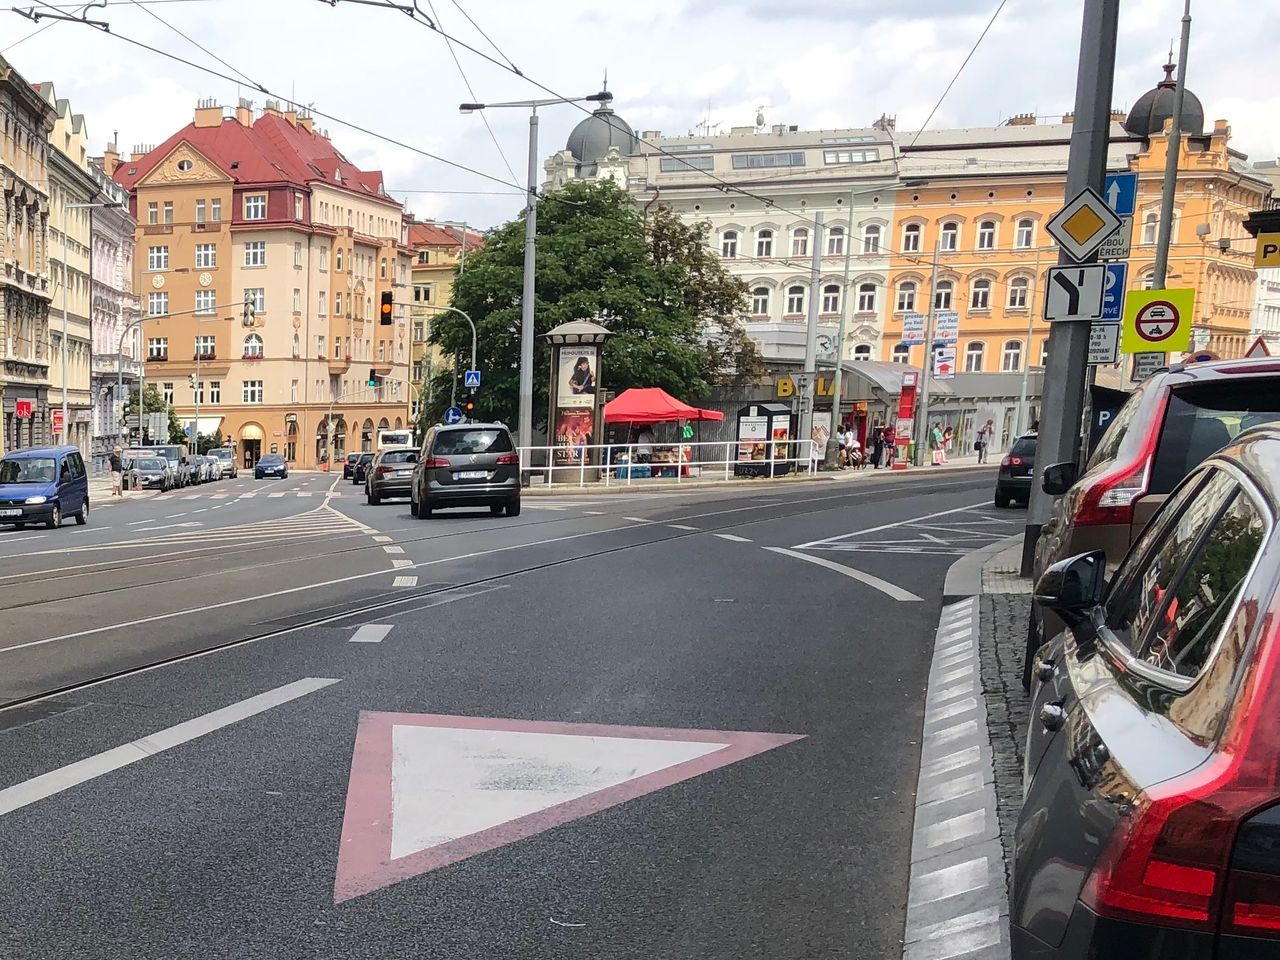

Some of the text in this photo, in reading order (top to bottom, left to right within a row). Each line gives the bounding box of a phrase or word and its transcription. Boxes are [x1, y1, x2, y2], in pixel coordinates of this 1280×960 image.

[1262, 244, 1280, 258] P
[778, 378, 843, 396] BLA
[17, 405, 30, 417] ok
[1099, 411, 1111, 426] P
